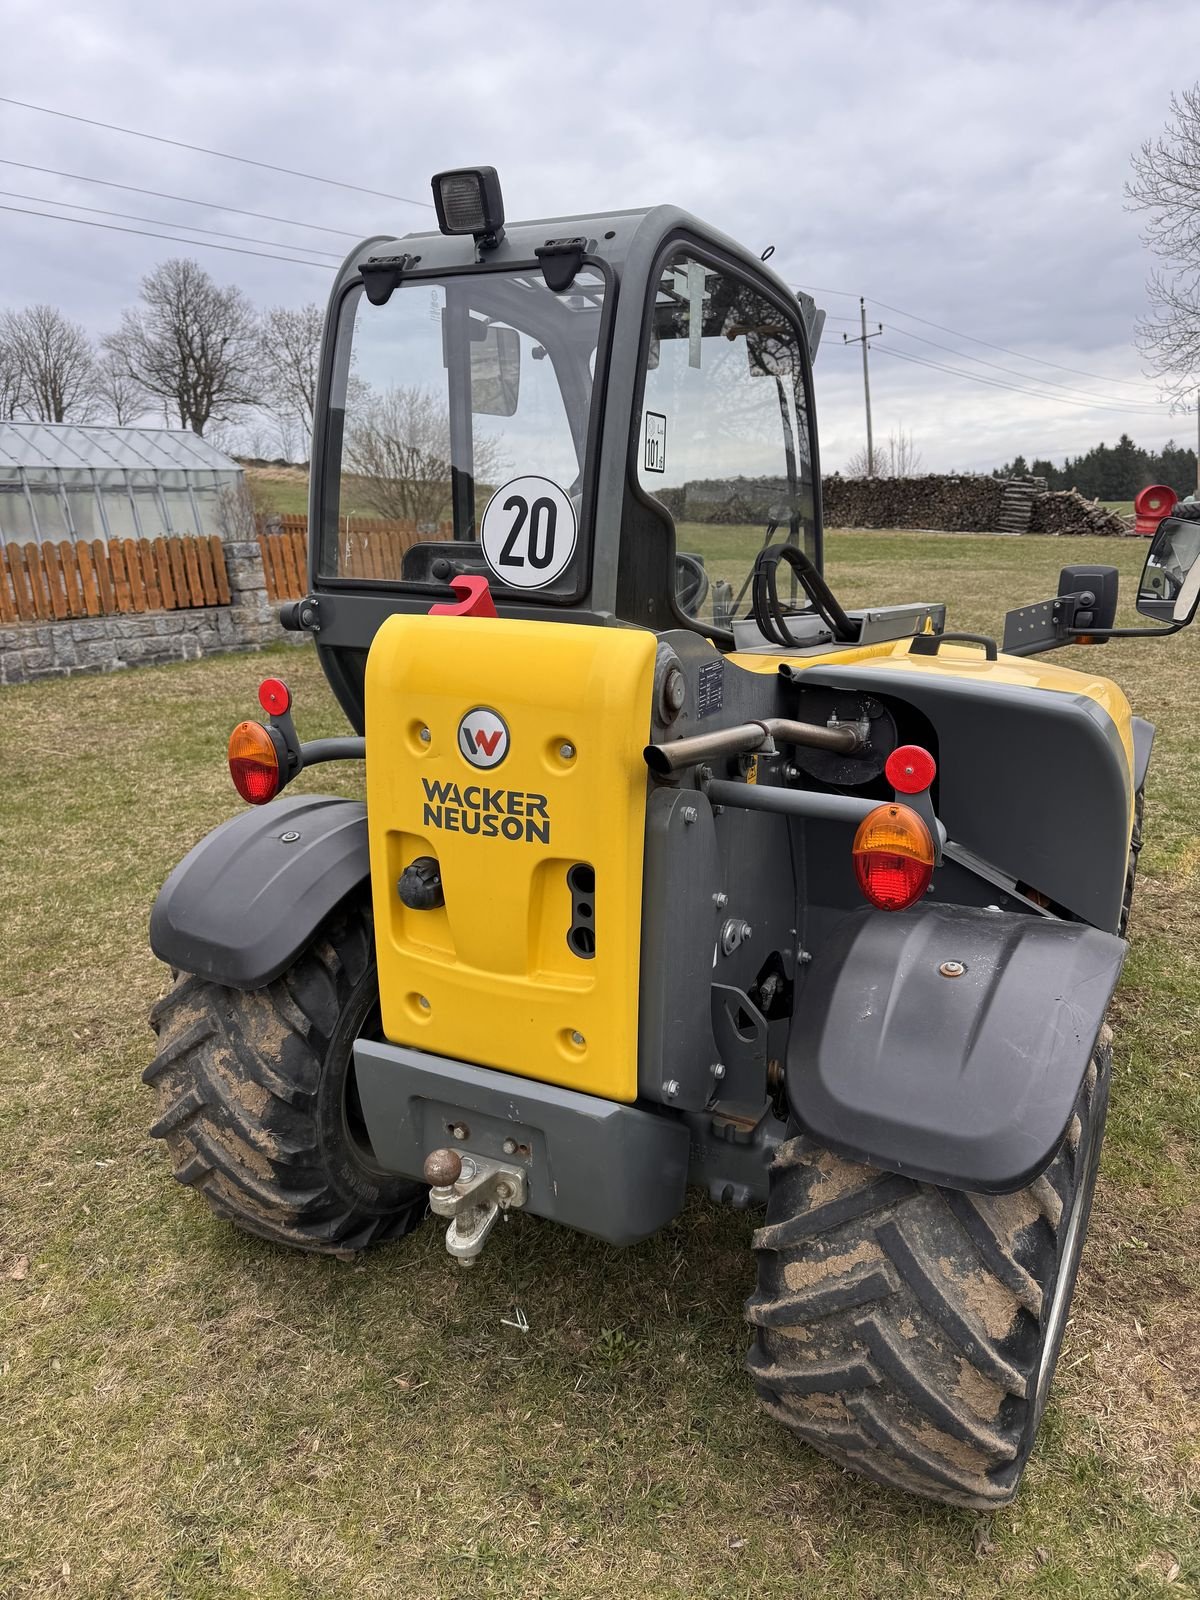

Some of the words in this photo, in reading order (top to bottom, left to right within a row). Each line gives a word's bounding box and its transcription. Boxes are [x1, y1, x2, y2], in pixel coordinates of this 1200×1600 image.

[647, 438, 659, 468] 101
[499, 494, 558, 570] 20
[462, 727, 504, 757] W
[421, 777, 550, 819] WACKER
[423, 803, 550, 845] NEUSON
